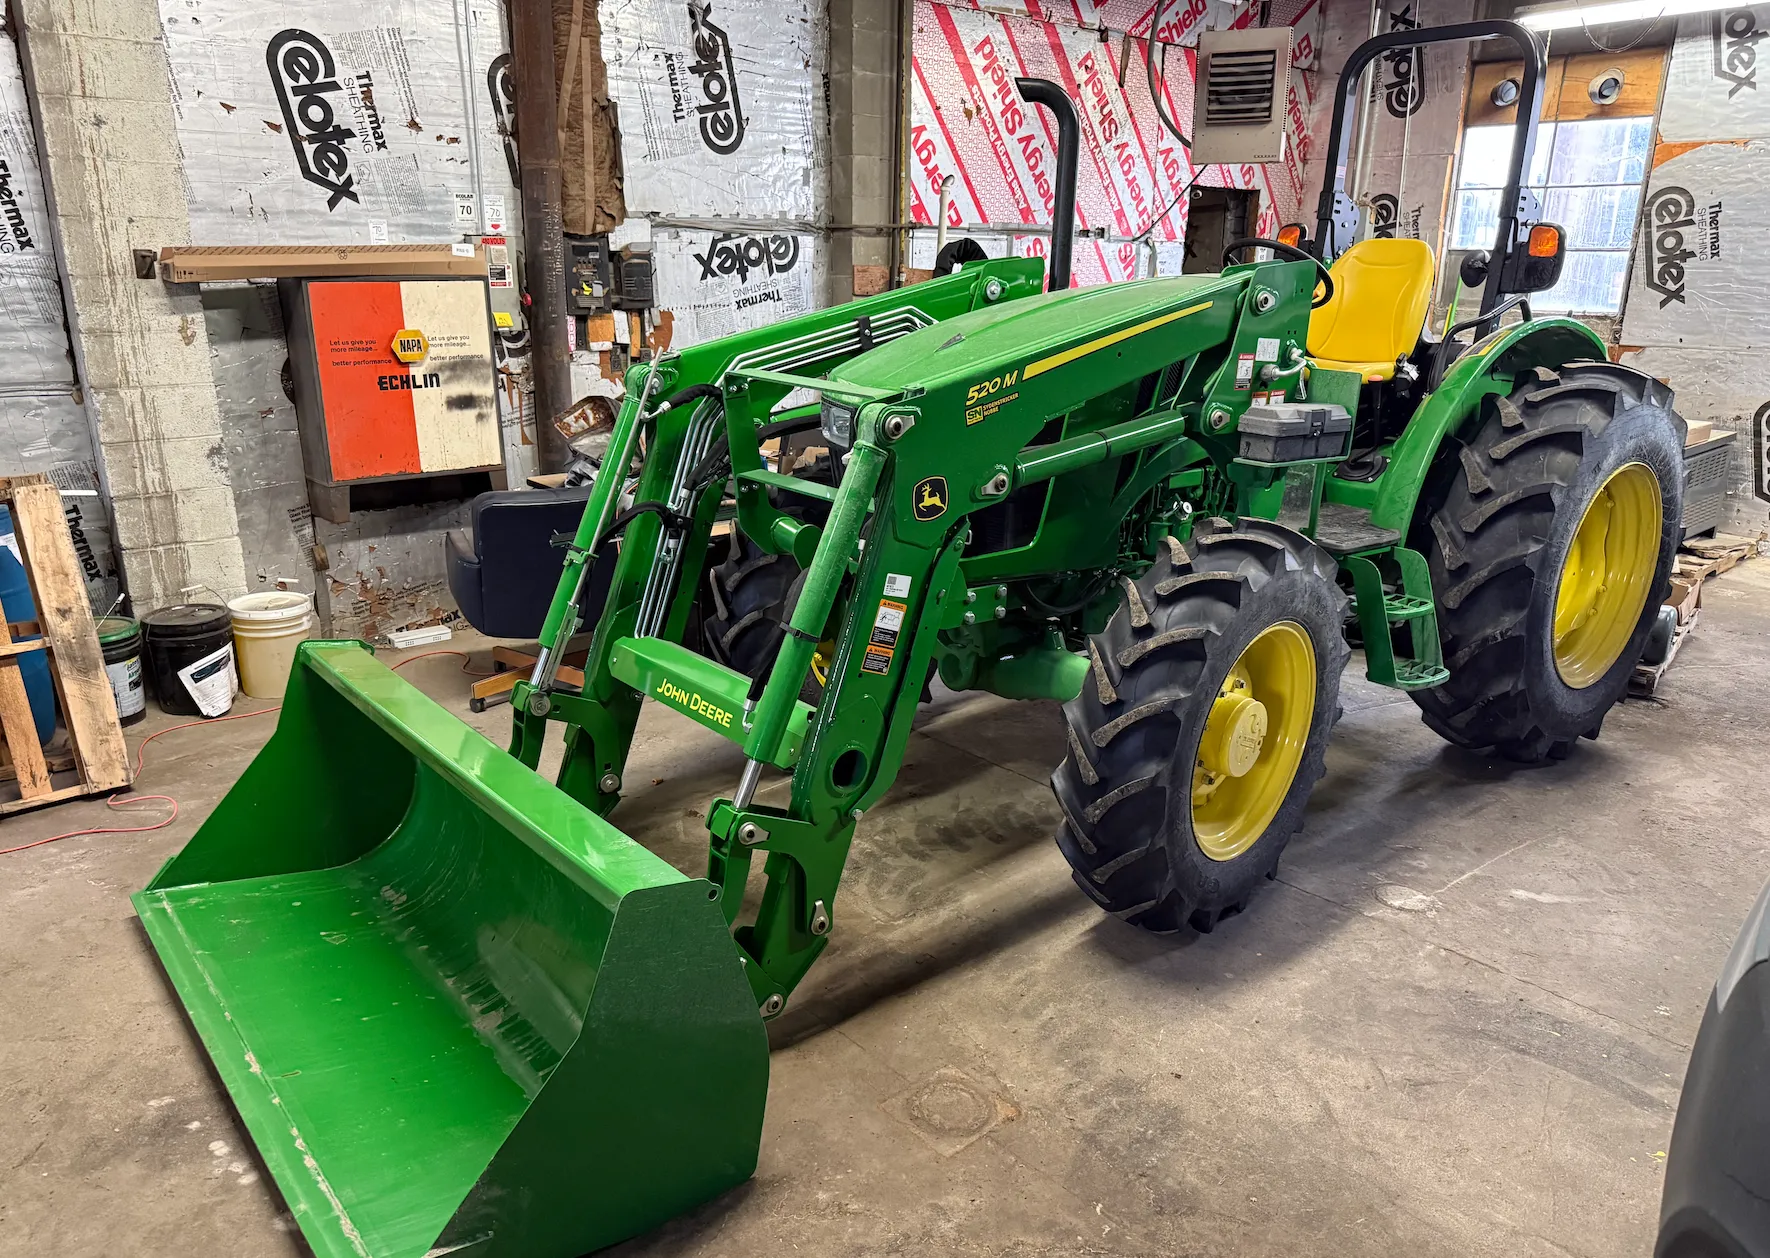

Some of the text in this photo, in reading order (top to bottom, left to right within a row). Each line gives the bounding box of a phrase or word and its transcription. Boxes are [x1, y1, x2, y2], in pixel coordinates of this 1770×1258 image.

[1156, 0, 1207, 43] Shield
[676, 52, 695, 117] SHEATHING
[687, 2, 746, 155] Celotex
[974, 34, 1024, 136] Shield
[1386, 5, 1425, 118] Celotx
[663, 53, 685, 123] Thermax
[1077, 51, 1119, 144] Shield
[266, 28, 360, 212] Celotex
[343, 77, 374, 155] SHEATHING
[970, 84, 1028, 210] Atlas Energy Products
[460, 206, 472, 215] 70
[490, 208, 500, 217] 70
[1113, 141, 1151, 236] Energy
[1644, 185, 1695, 310] Celotex
[1698, 207, 1708, 261] SHEATHING
[1708, 201, 1722, 260] Thermax
[693, 236, 799, 283] Celotex
[732, 277, 778, 297] SHEATHING
[735, 288, 782, 311] Thermax
[353, 358, 392, 366] performance
[400, 339, 422, 353] NAPA
[448, 353, 484, 362] performance
[377, 373, 440, 390] ECHLIN
[965, 370, 1018, 406] 520 M
[982, 392, 1019, 411] SYDENSTRICKER
[968, 408, 982, 420] SN
[64, 505, 102, 583] Thermax
[657, 678, 733, 728] JOHN DEERE
